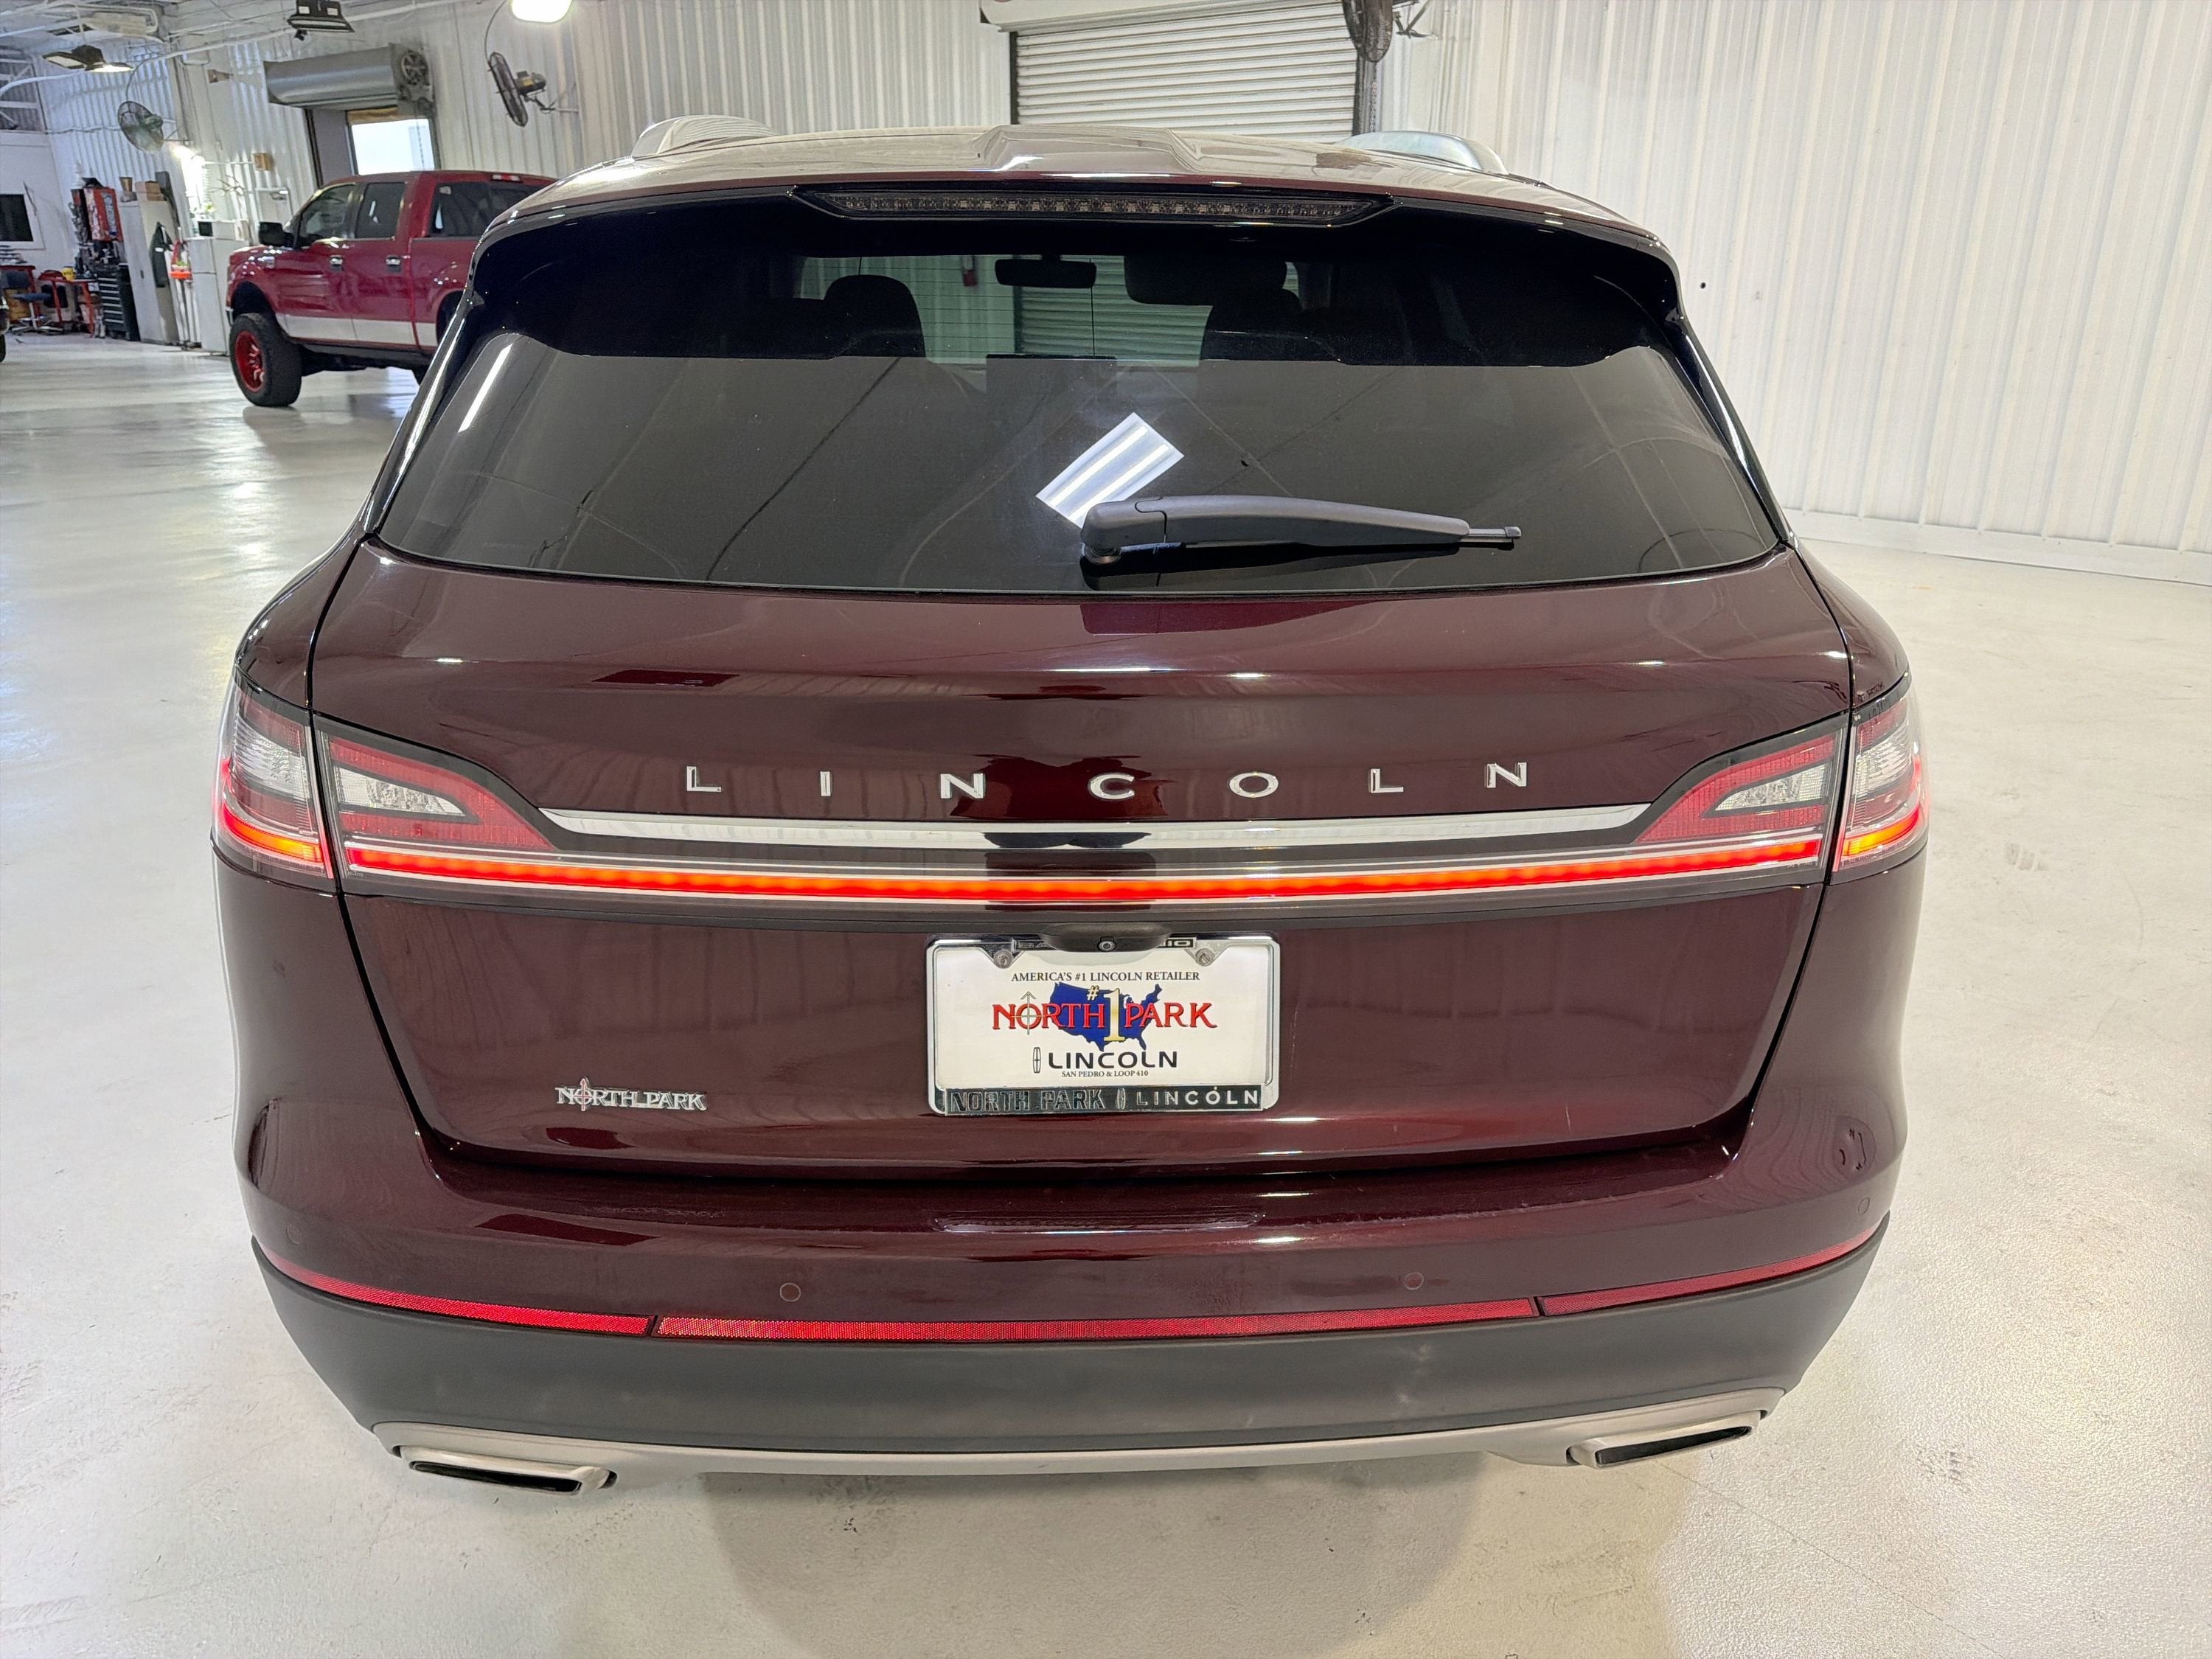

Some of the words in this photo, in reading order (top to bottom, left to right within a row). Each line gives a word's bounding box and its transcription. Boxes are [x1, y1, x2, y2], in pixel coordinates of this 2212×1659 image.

[686, 762, 1529, 801] LINCOLN
[1011, 971, 1072, 981] AMERICA'S
[1075, 972, 1087, 981] #1
[1090, 971, 1143, 981] LINCOLN
[1146, 971, 1200, 981] RETAILER
[992, 1002, 1105, 1030] NORTH
[1124, 1002, 1217, 1029] PARK
[1048, 1051, 1178, 1069] LINCOLN
[950, 1091, 1029, 1112] NORTH
[1041, 1089, 1105, 1110] PARK
[1136, 1090, 1259, 1106] LINCOLN
